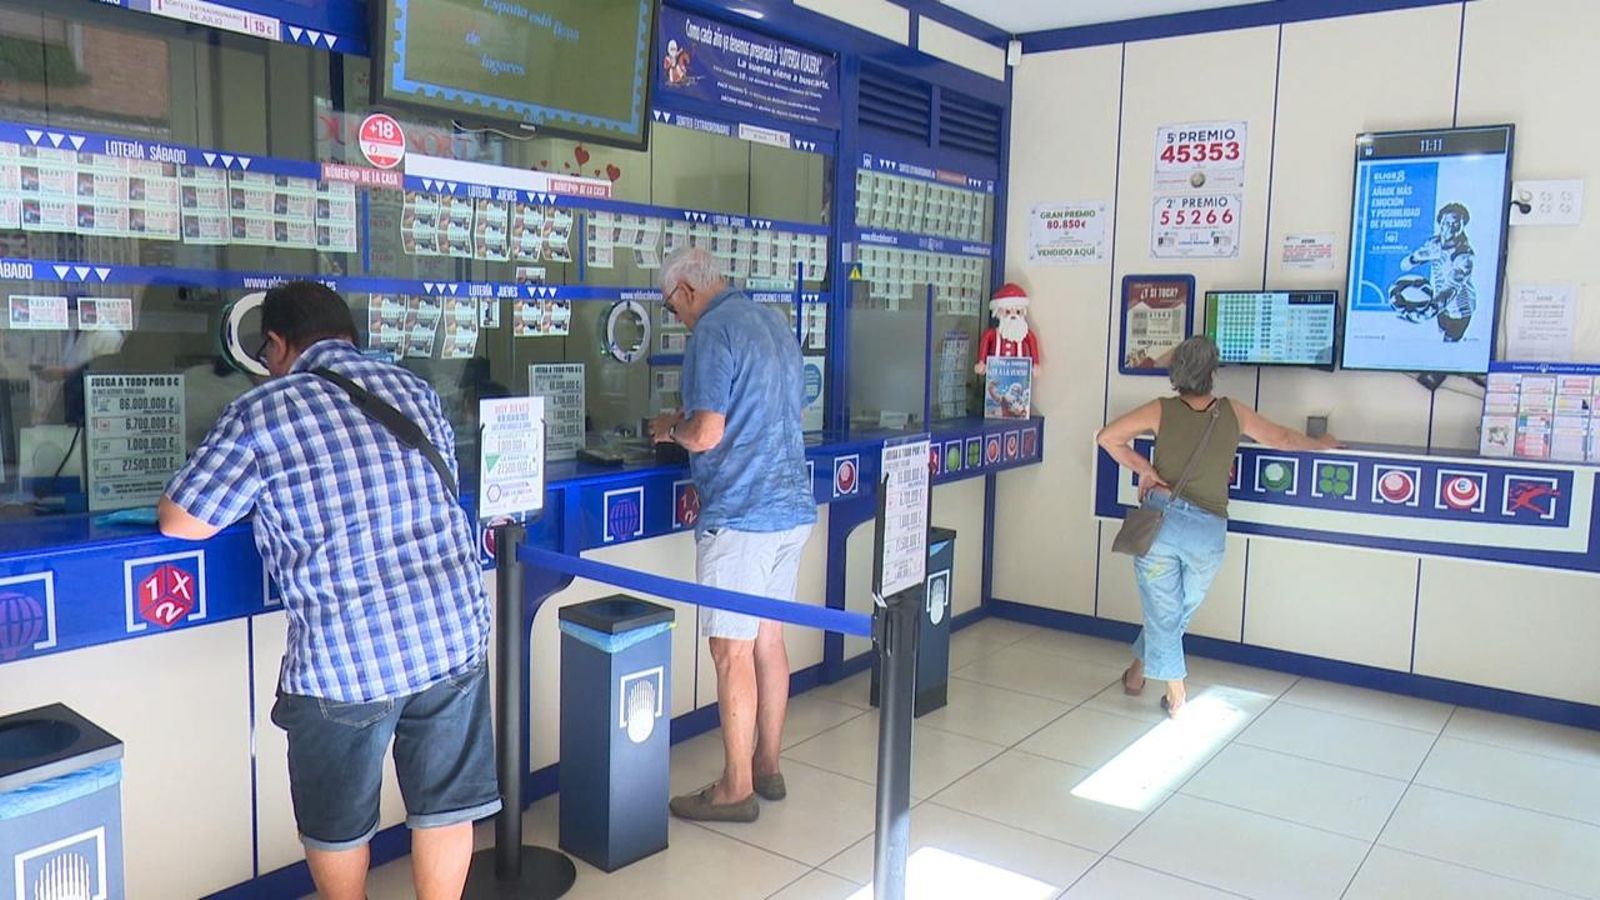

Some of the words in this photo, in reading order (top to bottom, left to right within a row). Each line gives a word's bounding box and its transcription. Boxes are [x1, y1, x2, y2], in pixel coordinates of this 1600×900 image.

[737, 57, 747, 69] La
[748, 61, 771, 78] suerte
[772, 69, 791, 83] viene
[369, 120, 394, 140] +18
[1179, 129, 1235, 143] PREMIO
[105, 139, 145, 160] LOTERÍA
[149, 144, 187, 166] SÁBADO
[1160, 142, 1240, 164] 45353
[1420, 138, 1442, 153] 11:11
[1182, 197, 1228, 208] PREMIO
[1039, 211, 1064, 220] GRAN
[1064, 209, 1097, 219] PREMIO
[1037, 248, 1074, 257] VENDIDO
[469, 281, 493, 297] LOTERÍA
[497, 285, 518, 299] JUEVES
[91, 377, 116, 387] JUEGA
[118, 377, 124, 386] A
[125, 377, 147, 387] TODO
[145, 576, 159, 601] 1
[172, 570, 191, 600] X
[155, 601, 183, 622] 2
